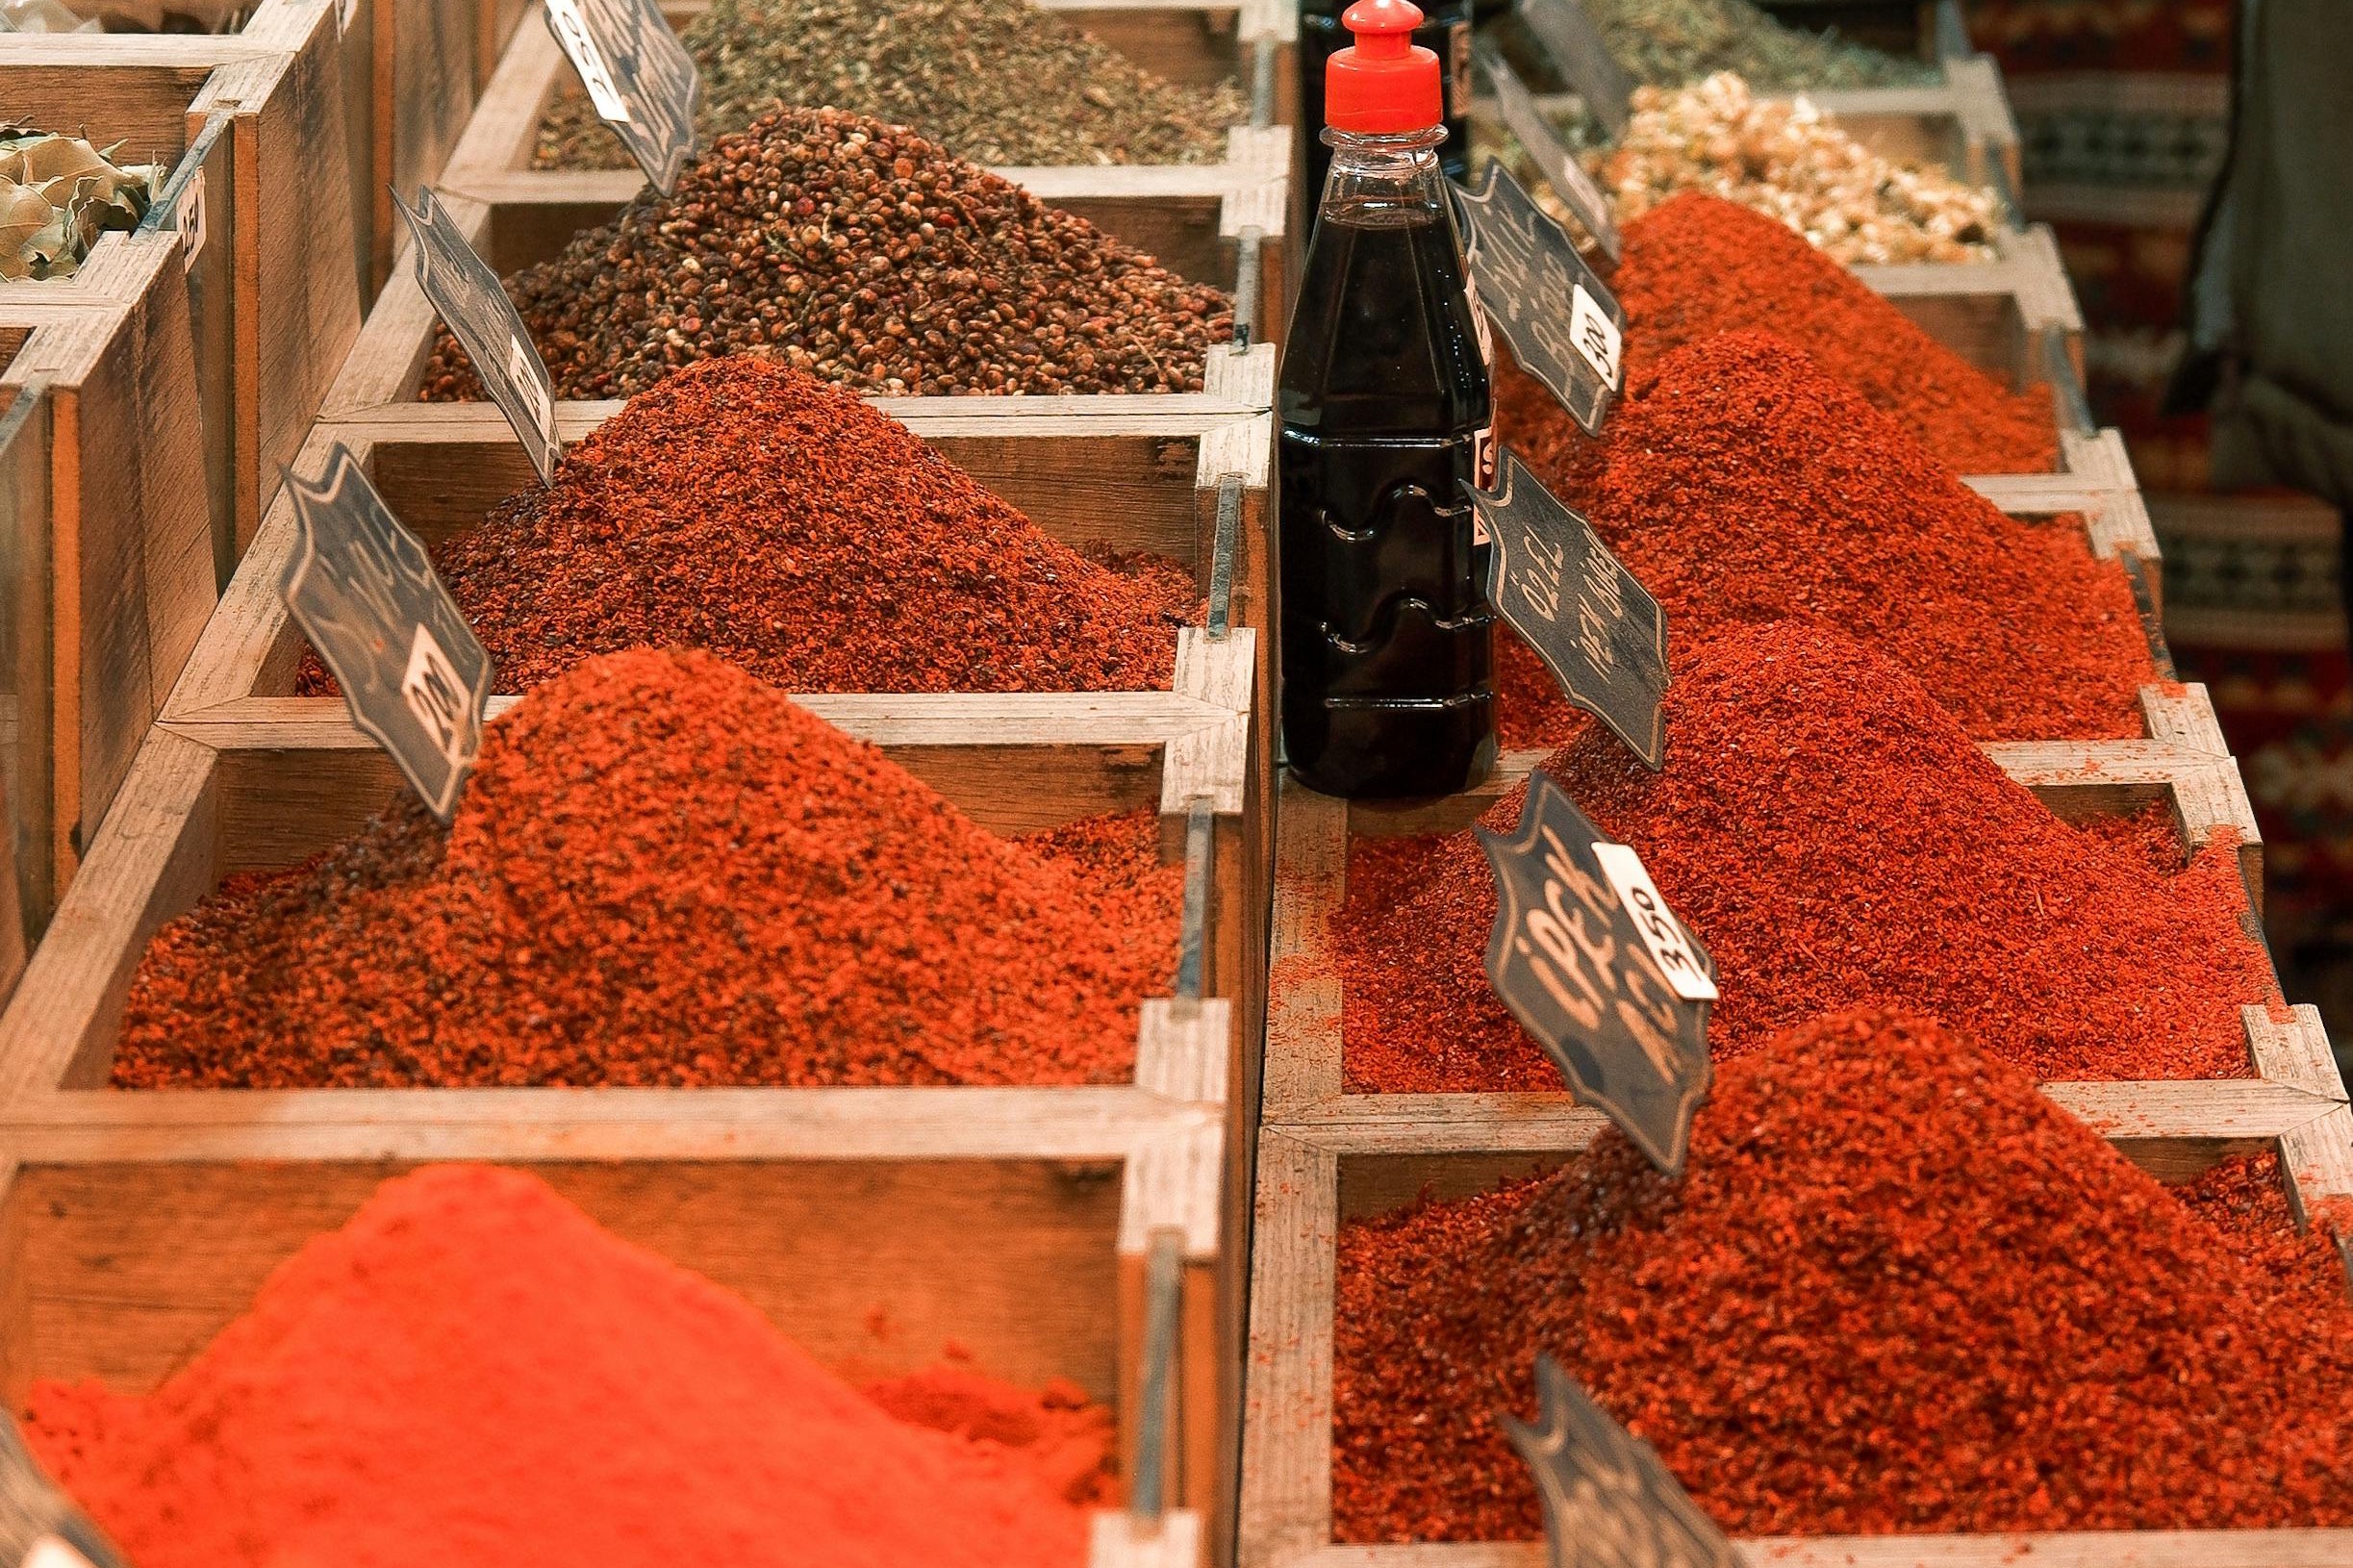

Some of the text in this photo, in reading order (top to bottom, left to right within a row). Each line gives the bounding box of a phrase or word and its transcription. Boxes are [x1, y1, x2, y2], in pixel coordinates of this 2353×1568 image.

[1583, 313, 1613, 378] 300
[1510, 525, 1563, 622] ÖZEL
[1570, 592, 1614, 684] İPEK
[411, 651, 462, 751] 200
[1515, 824, 1621, 1030] İPEK
[1632, 886, 1703, 982] 350
